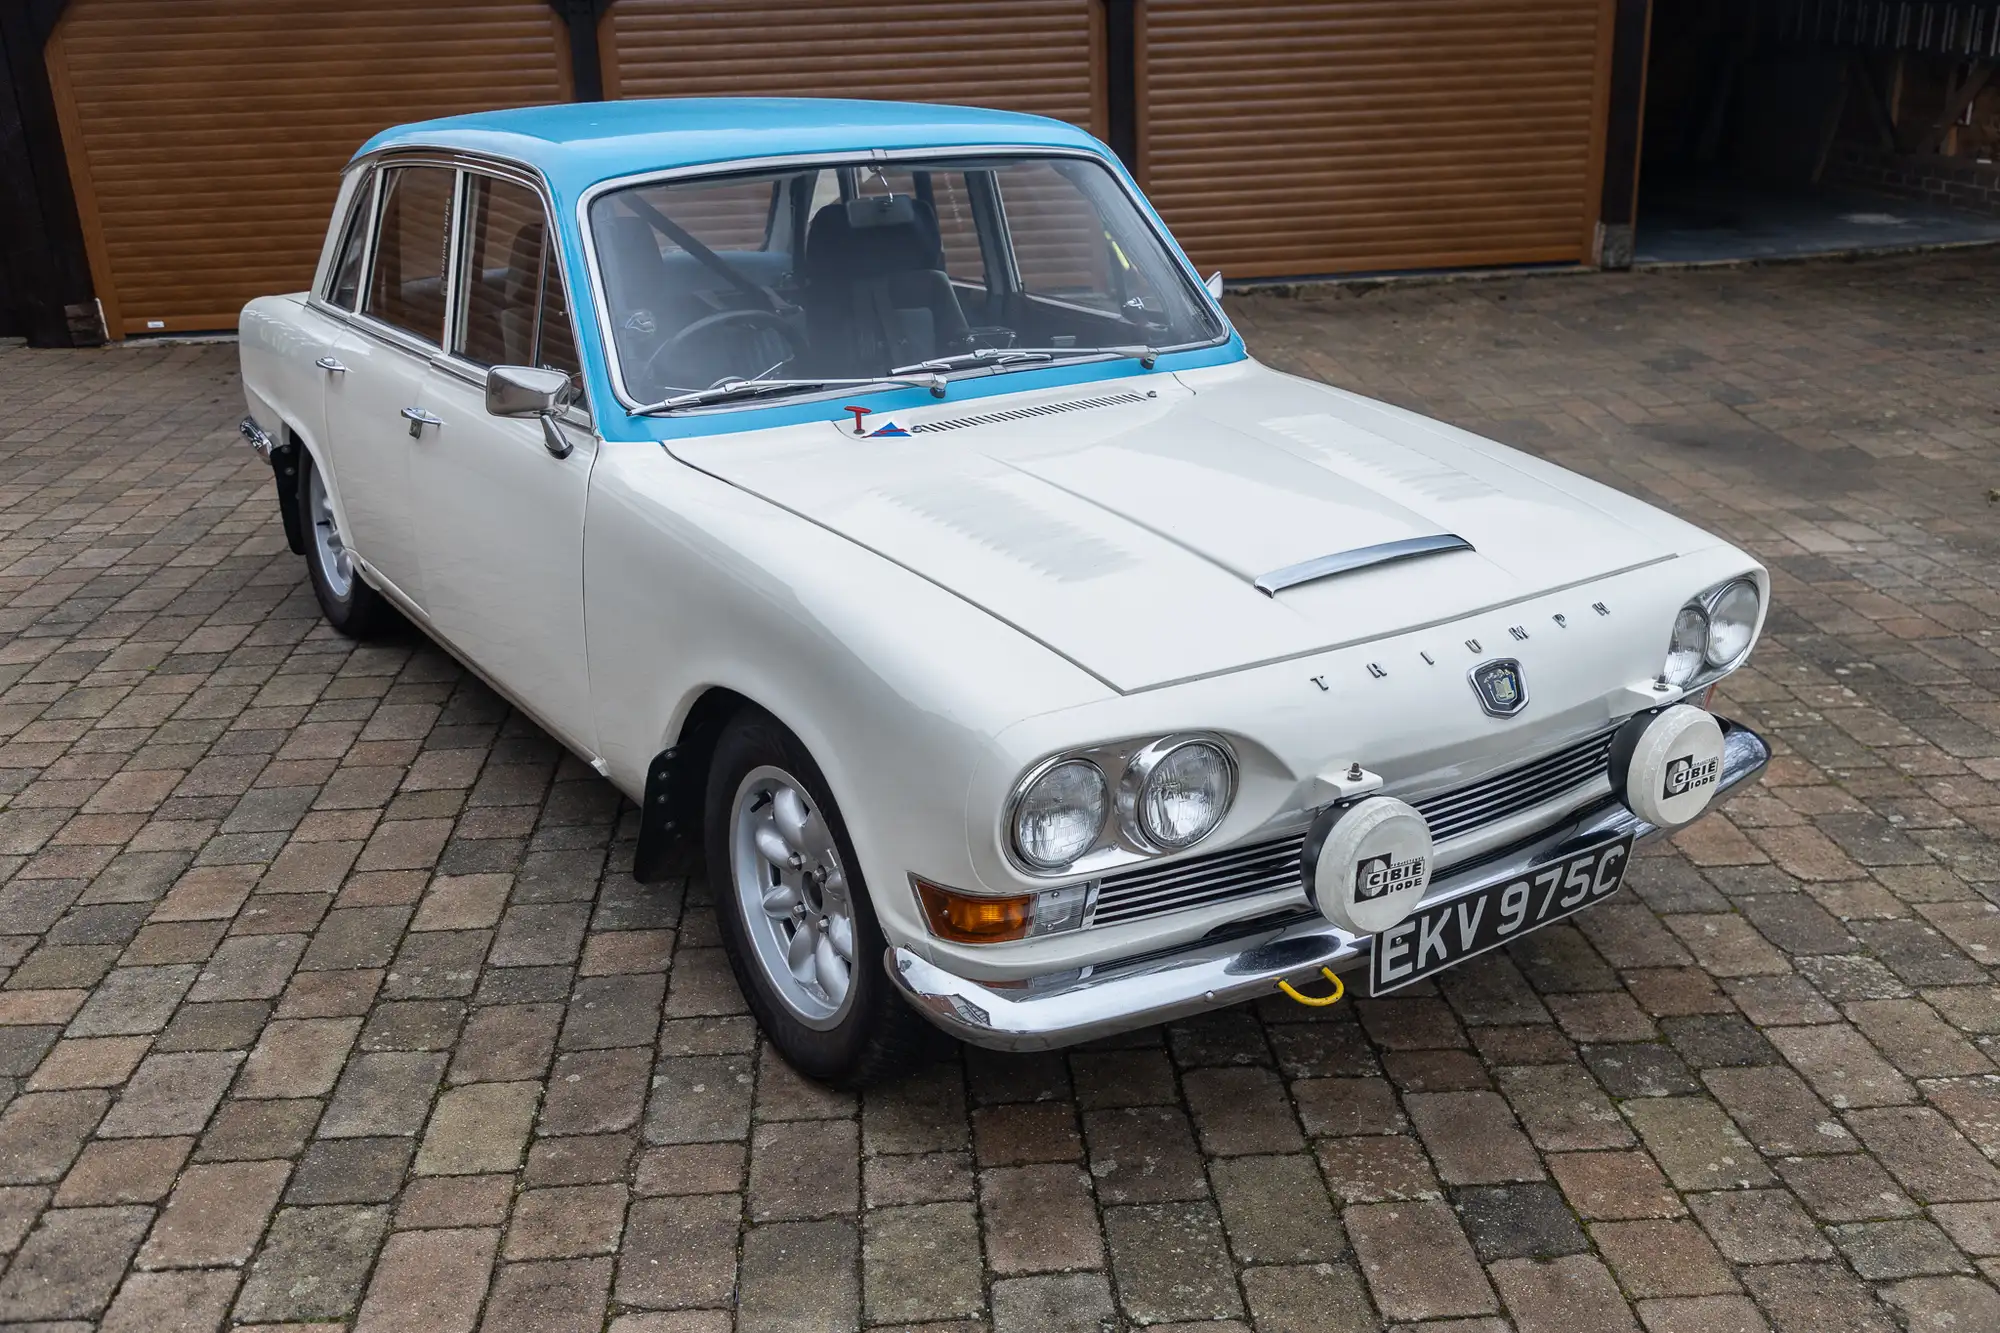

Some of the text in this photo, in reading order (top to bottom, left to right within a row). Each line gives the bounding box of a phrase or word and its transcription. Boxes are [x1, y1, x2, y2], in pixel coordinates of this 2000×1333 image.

[1310, 601, 1610, 691] TRIUMPH
[1690, 774, 1716, 790] IODE
[1390, 877, 1423, 893] IODE
[1380, 845, 1624, 984] EKV 975C
